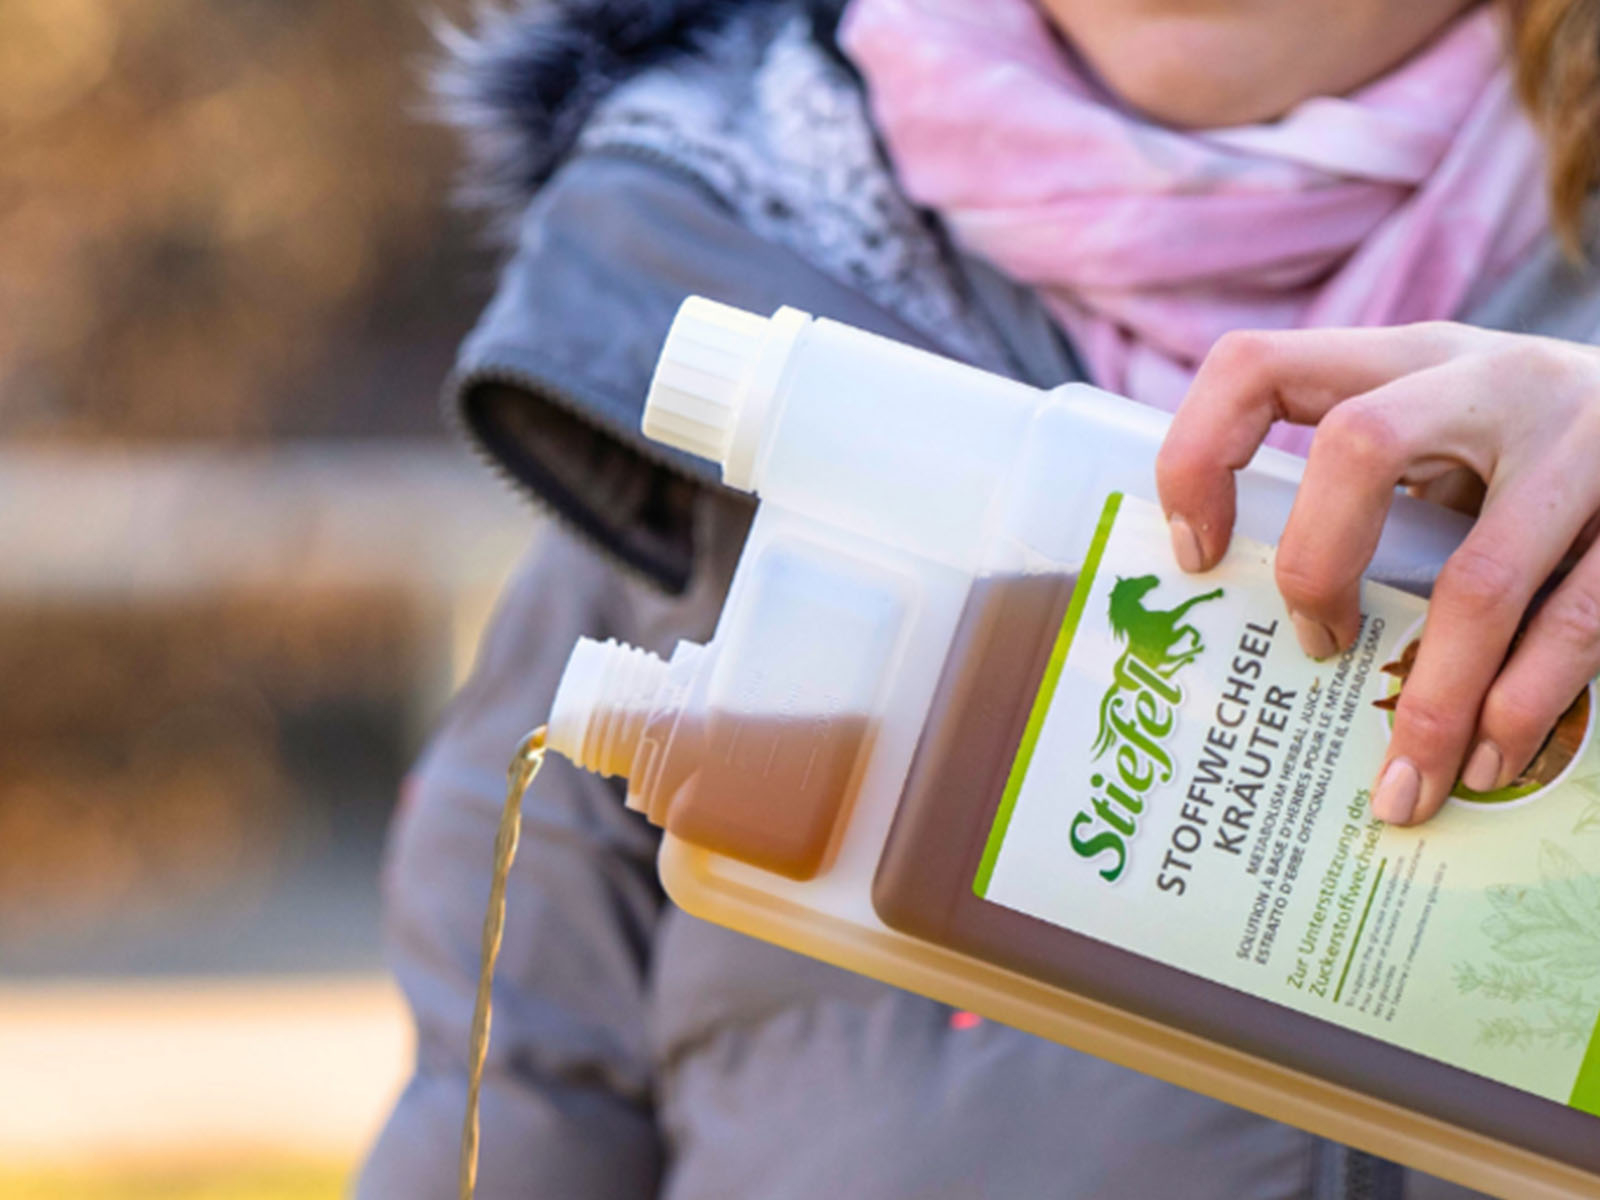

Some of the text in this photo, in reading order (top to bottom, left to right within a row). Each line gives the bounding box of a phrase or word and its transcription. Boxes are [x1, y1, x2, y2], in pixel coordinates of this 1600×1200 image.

[1333, 723, 1348, 737] IL
[1338, 616, 1387, 722] METABOLISMO
[1069, 655, 1182, 882] Stiefel
[1157, 619, 1278, 896] STOFFWECHSEL
[1214, 688, 1297, 856] KRÄUTER
[1245, 783, 1289, 876] METABOLISM
[1278, 726, 1308, 781] HERBAL
[1295, 766, 1333, 844] OFFICINALI
[1323, 738, 1343, 766] PER
[1235, 891, 1271, 960] SOLUTION
[1264, 839, 1288, 877] BASE
[1302, 729, 1326, 770] POUR
[1316, 711, 1332, 729] LE
[1286, 785, 1369, 989] Zur Unterstützung des
[1305, 815, 1387, 997] Zuckerstoffwechsels
[1253, 895, 1289, 964] ESTRATTO
